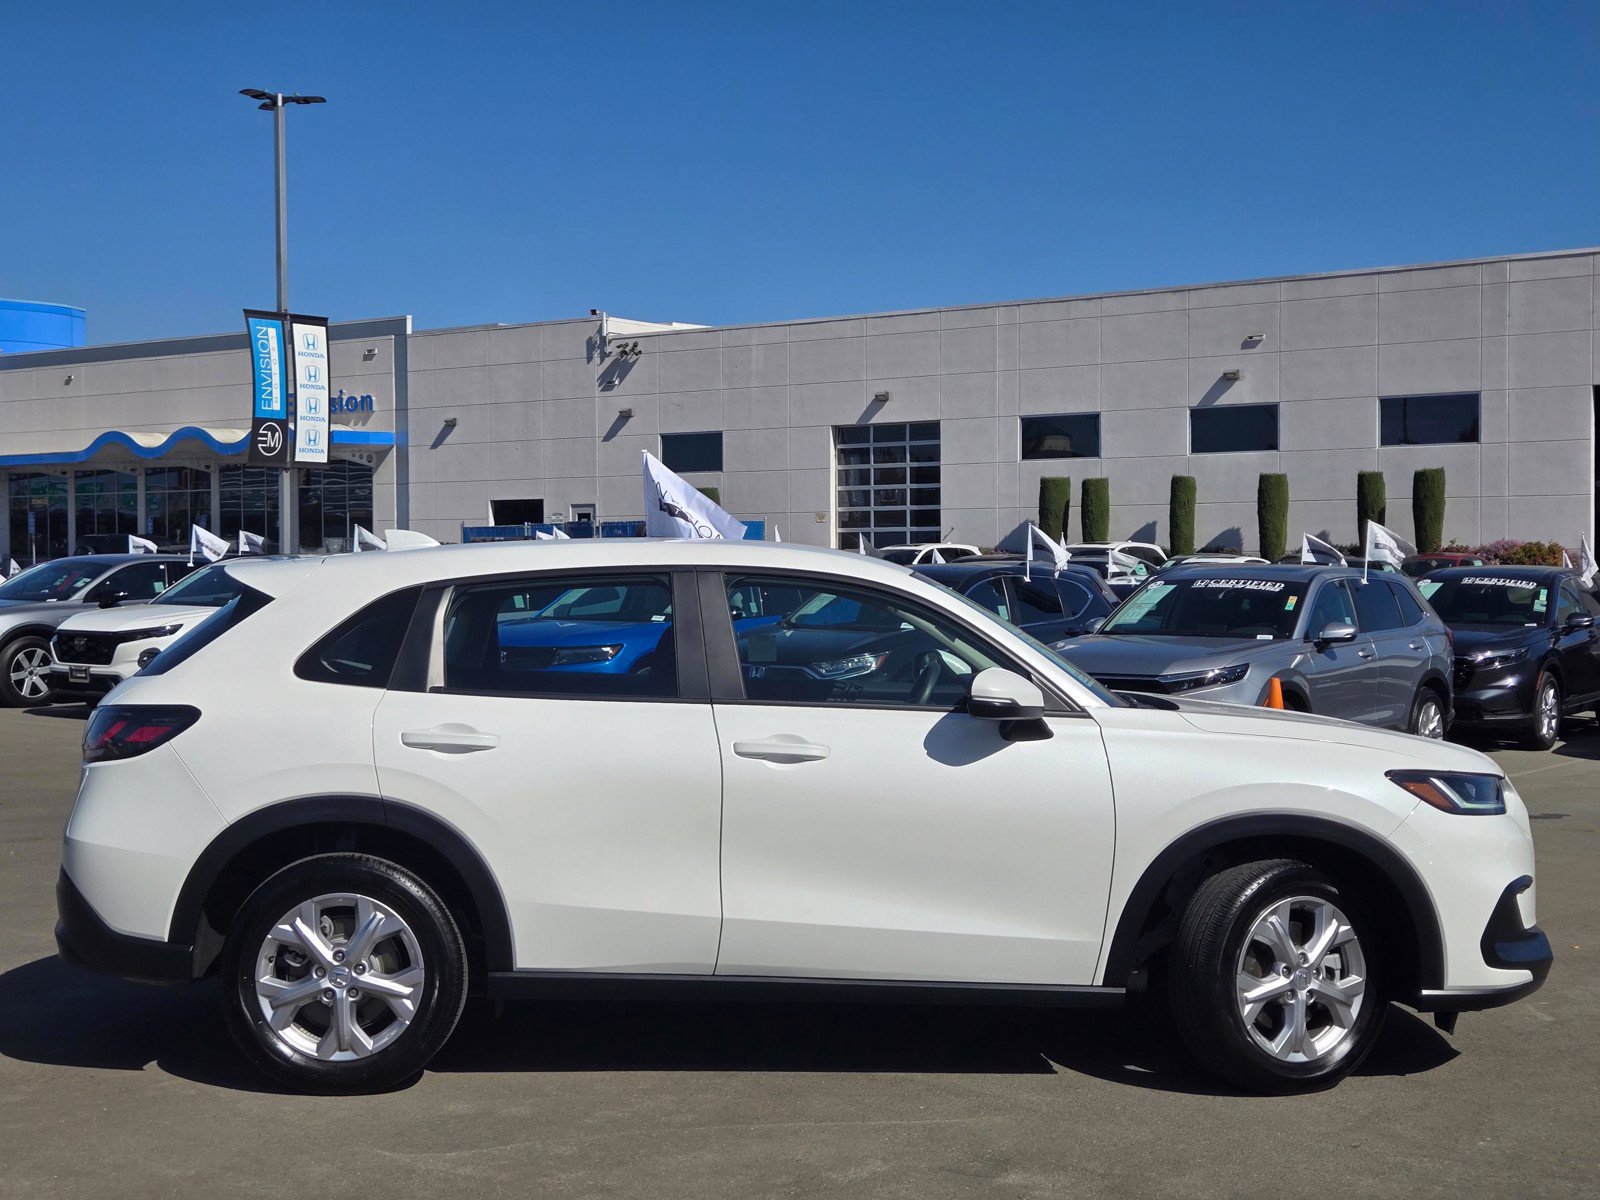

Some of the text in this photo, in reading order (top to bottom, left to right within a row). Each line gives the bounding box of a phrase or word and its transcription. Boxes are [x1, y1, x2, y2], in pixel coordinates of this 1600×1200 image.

[298, 351, 325, 359] HONDA
[256, 326, 273, 410] ENVISION
[271, 336, 280, 404] MOTORS
[299, 383, 327, 391] HONDA
[299, 415, 327, 423] HONDA
[1209, 579, 1285, 588] CERTIFIED
[1475, 577, 1537, 587] CERTIFIED
